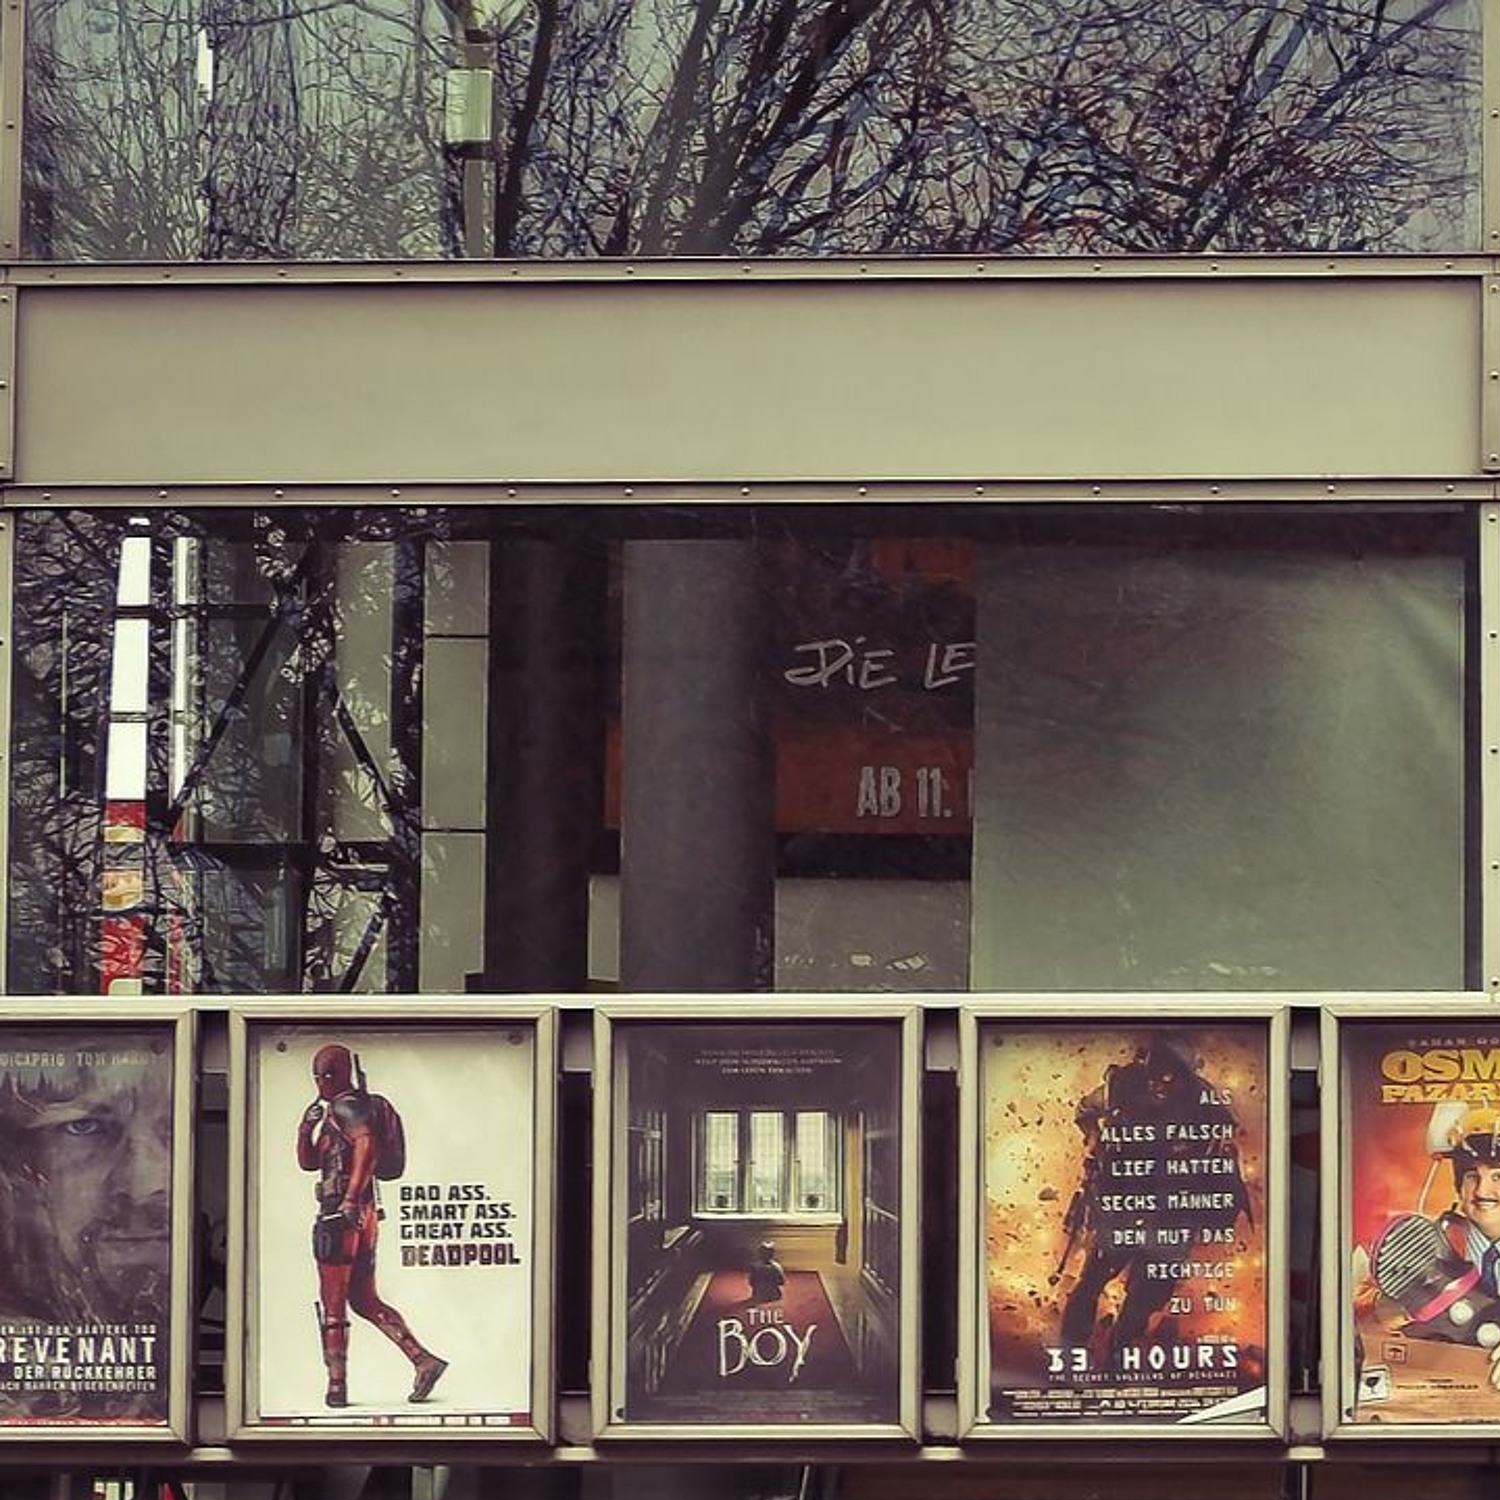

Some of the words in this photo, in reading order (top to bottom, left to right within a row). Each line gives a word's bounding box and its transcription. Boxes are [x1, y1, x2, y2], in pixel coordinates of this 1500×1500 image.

[856, 766, 901, 817] AB
[1199, 1089, 1232, 1106] ALS
[1100, 1125, 1156, 1142] ALLES
[1165, 1123, 1233, 1140] FALSCH
[1111, 1160, 1156, 1176] LIEF
[1166, 1158, 1234, 1175] HATTEN
[400, 1184, 440, 1201] BAD
[447, 1184, 491, 1201] ASS.
[1101, 1194, 1156, 1211] SECHS
[1167, 1190, 1234, 1210] MÄNNER
[400, 1203, 469, 1221] SMART
[474, 1202, 517, 1220] ASS.
[400, 1222, 464, 1240] GREAT
[470, 1221, 512, 1239] ASS.
[1113, 1229, 1146, 1245] DEN
[1157, 1229, 1191, 1245] MUT
[1202, 1228, 1235, 1243] DAS
[401, 1242, 521, 1267] DEADPOOL
[1146, 1262, 1234, 1279] RICHTIGE
[1169, 1297, 1191, 1314] ZU
[1203, 1296, 1237, 1312] TUN
[746, 1307, 785, 1326] THE
[717, 1318, 818, 1383] BOY
[1122, 1345, 1238, 1370] HOURS
[14, 1365, 45, 1380] DER
